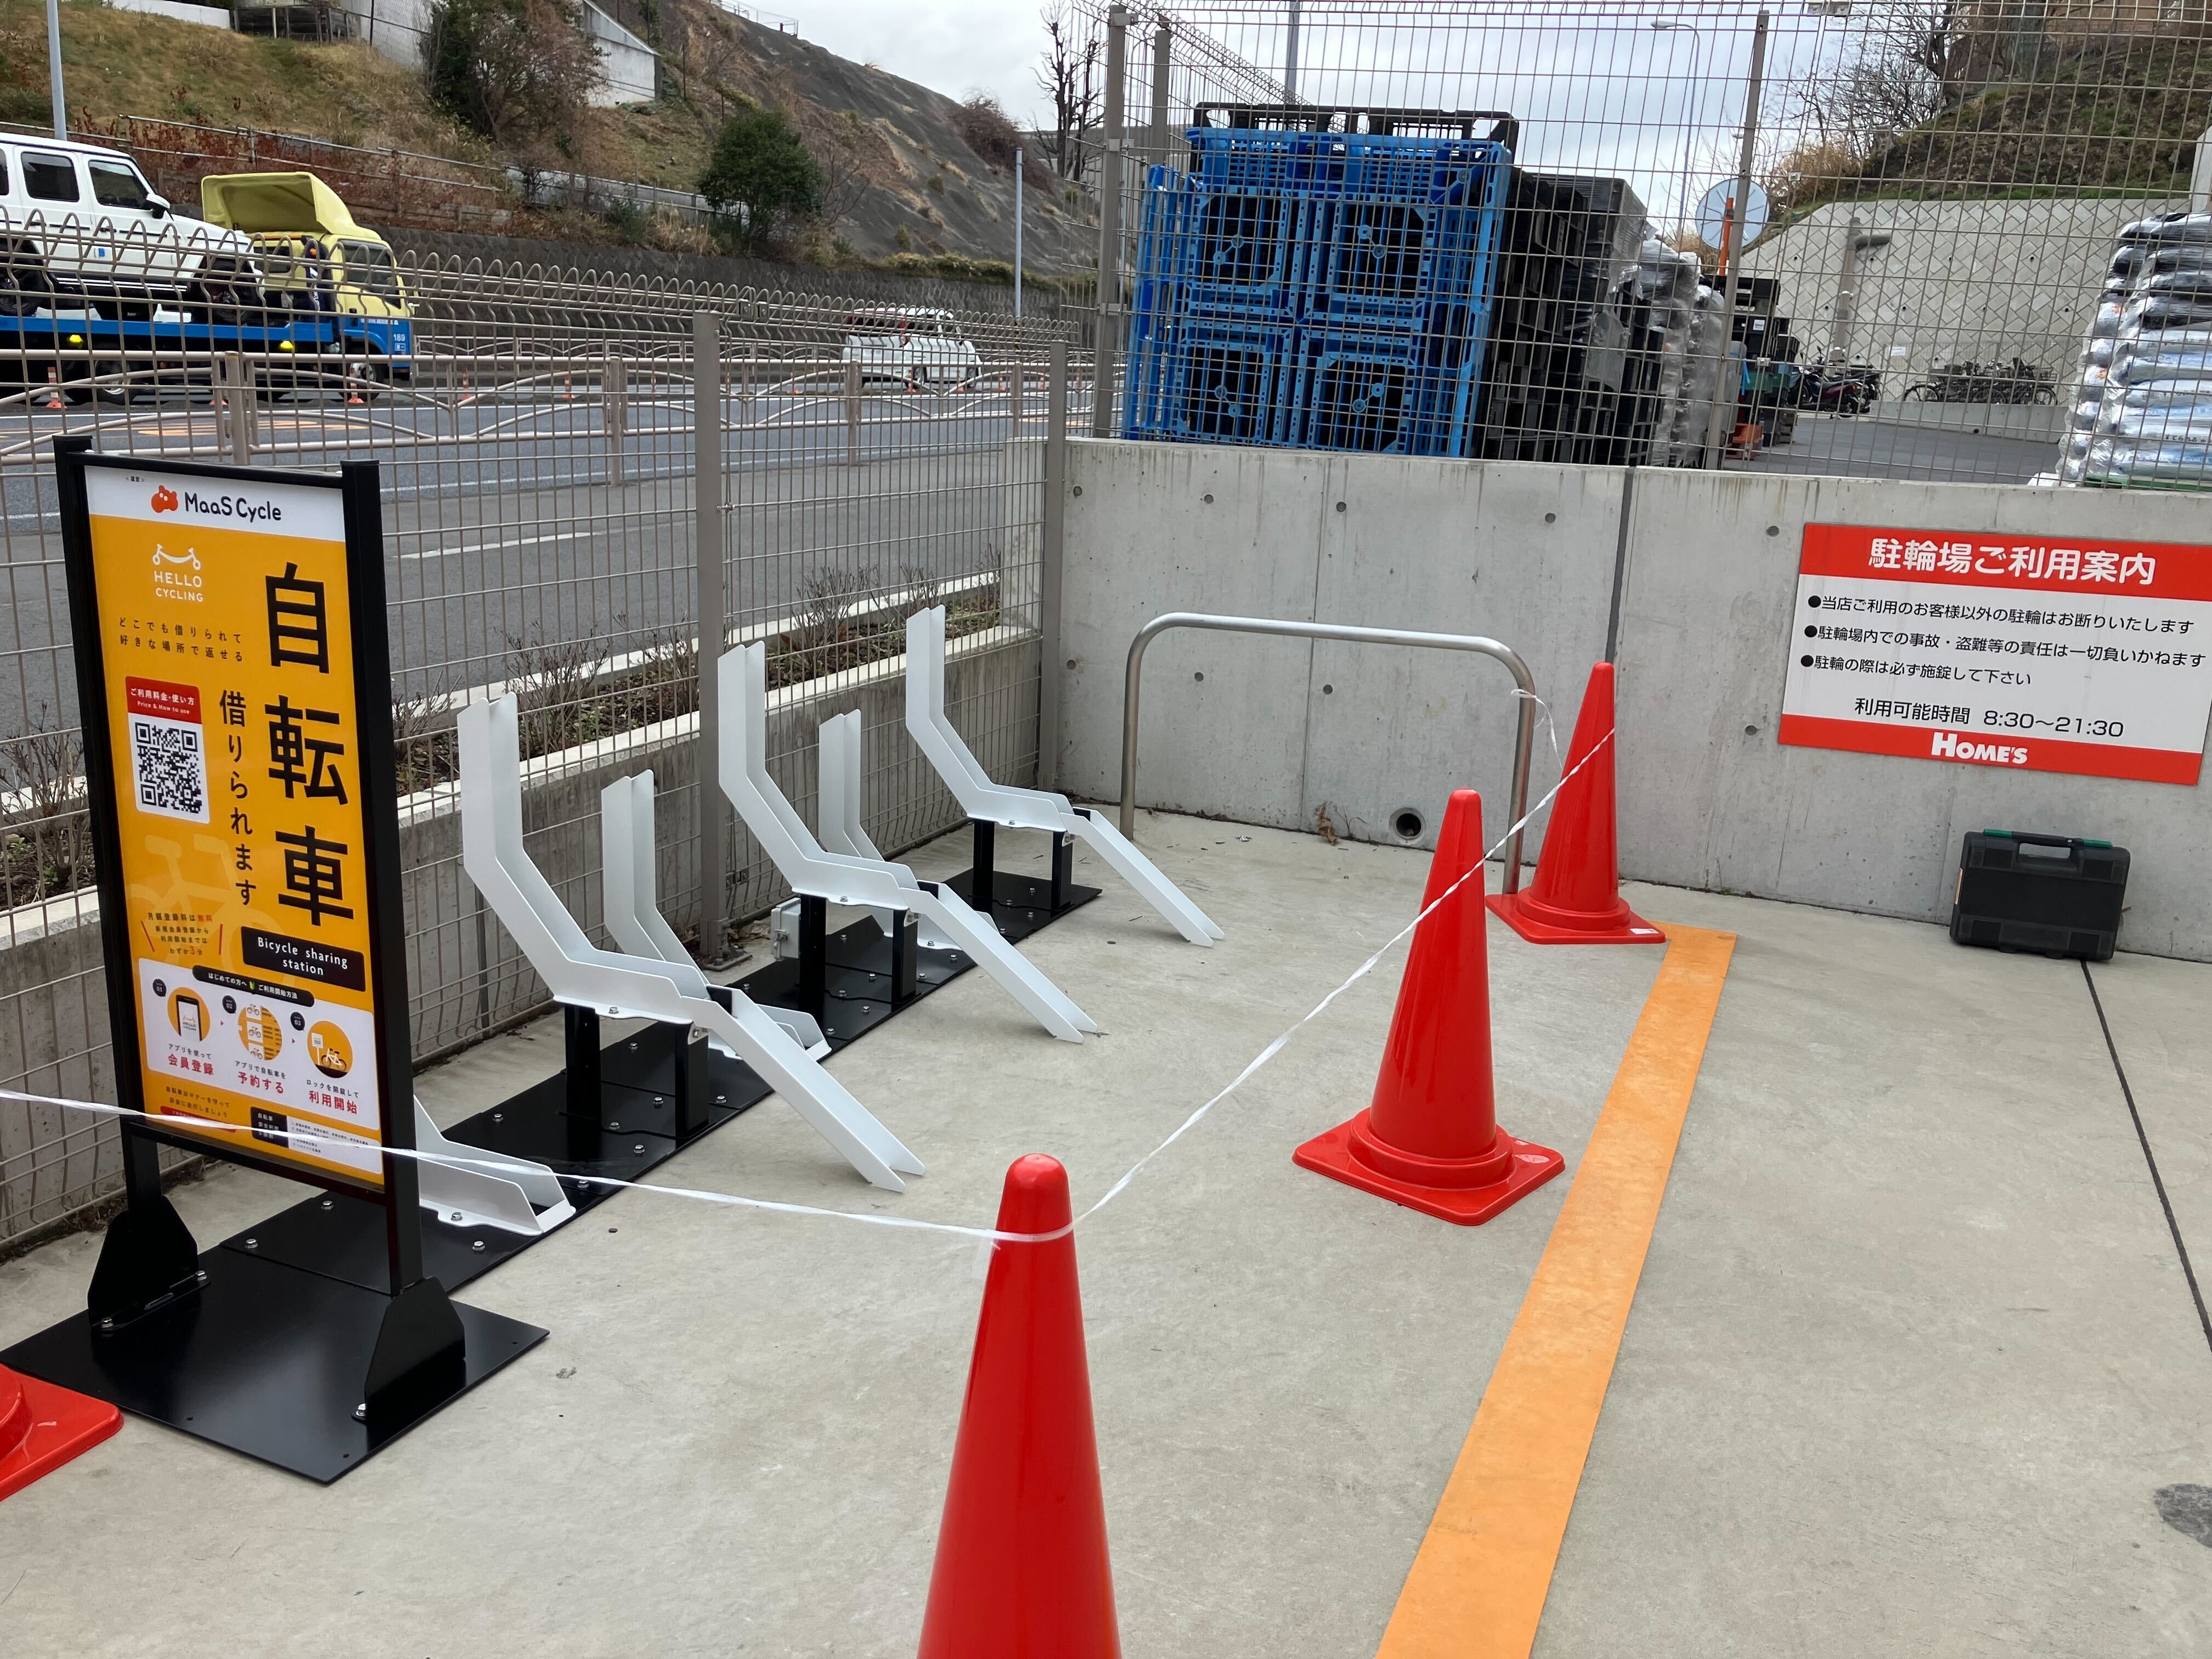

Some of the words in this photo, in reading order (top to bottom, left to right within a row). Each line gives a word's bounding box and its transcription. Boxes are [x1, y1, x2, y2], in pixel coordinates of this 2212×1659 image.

[184, 492, 233, 517] MaaS
[236, 497, 281, 523] Cycle
[1868, 538, 2156, 585] 駐輪場ご利用案内
[154, 570, 202, 588] HELLO
[156, 588, 204, 602] CYCLING
[1821, 596, 2194, 635] 当店ご利用のお客様以外の駐輪はお断りいたします
[119, 617, 242, 644] どこでも借りられて
[119, 634, 243, 662] 好きな場所で返せる
[1818, 625, 2207, 668] 駐輪場内での事故・盗難等の責任は一切負いかねます
[1814, 655, 2032, 686] 駐輪の際は必ず施錠して下さい
[137, 700, 151, 709] Price
[1854, 698, 1970, 724] 利用可能時間
[264, 562, 354, 927] 自転車
[219, 689, 257, 906] 借りられます
[257, 936, 298, 956] Bicycle
[305, 947, 348, 969] sharing
[208, 972, 247, 986] はじめての方へ
[283, 958, 324, 976] station
[168, 1053, 214, 1075] 会員登録
[238, 1071, 284, 1094] 予約する
[308, 1090, 358, 1115] 利用開始
